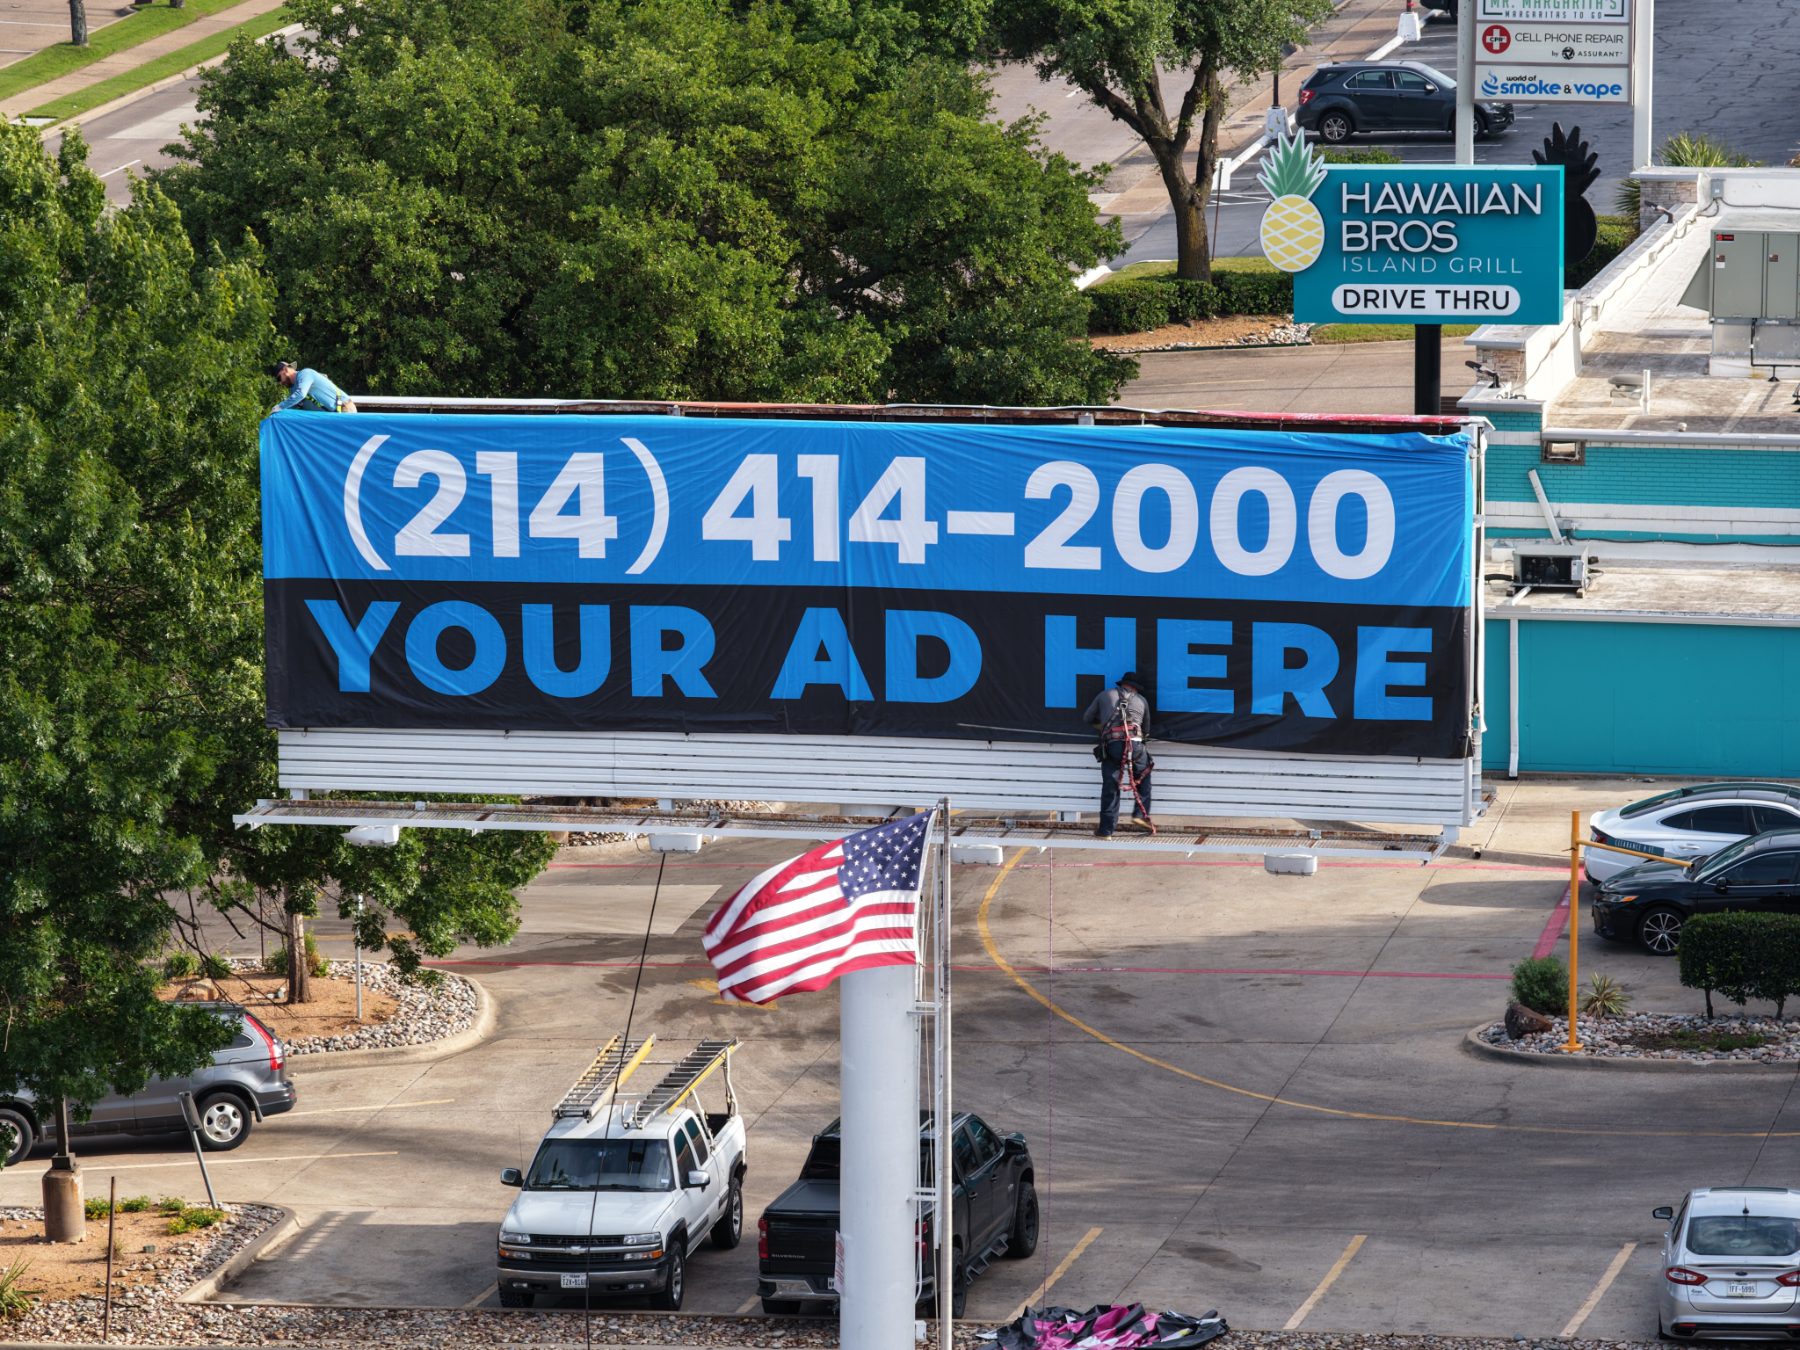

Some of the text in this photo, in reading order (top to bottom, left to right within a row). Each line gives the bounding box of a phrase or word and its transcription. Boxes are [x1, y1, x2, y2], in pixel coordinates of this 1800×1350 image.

[1505, 10, 1602, 19] MARGARITAS TO GO
[1515, 32, 1624, 44] CELL PHONE REPAIR
[1500, 80, 1622, 99] smoke & vape
[1342, 182, 1542, 215] HAWAIIAN
[1342, 220, 1458, 253] BROS
[1342, 256, 1523, 274] ISLAND GRILL
[1343, 289, 1510, 310] DRIVE THRU
[344, 434, 670, 575] (214)
[304, 599, 1434, 721] YOUR AD HERE
